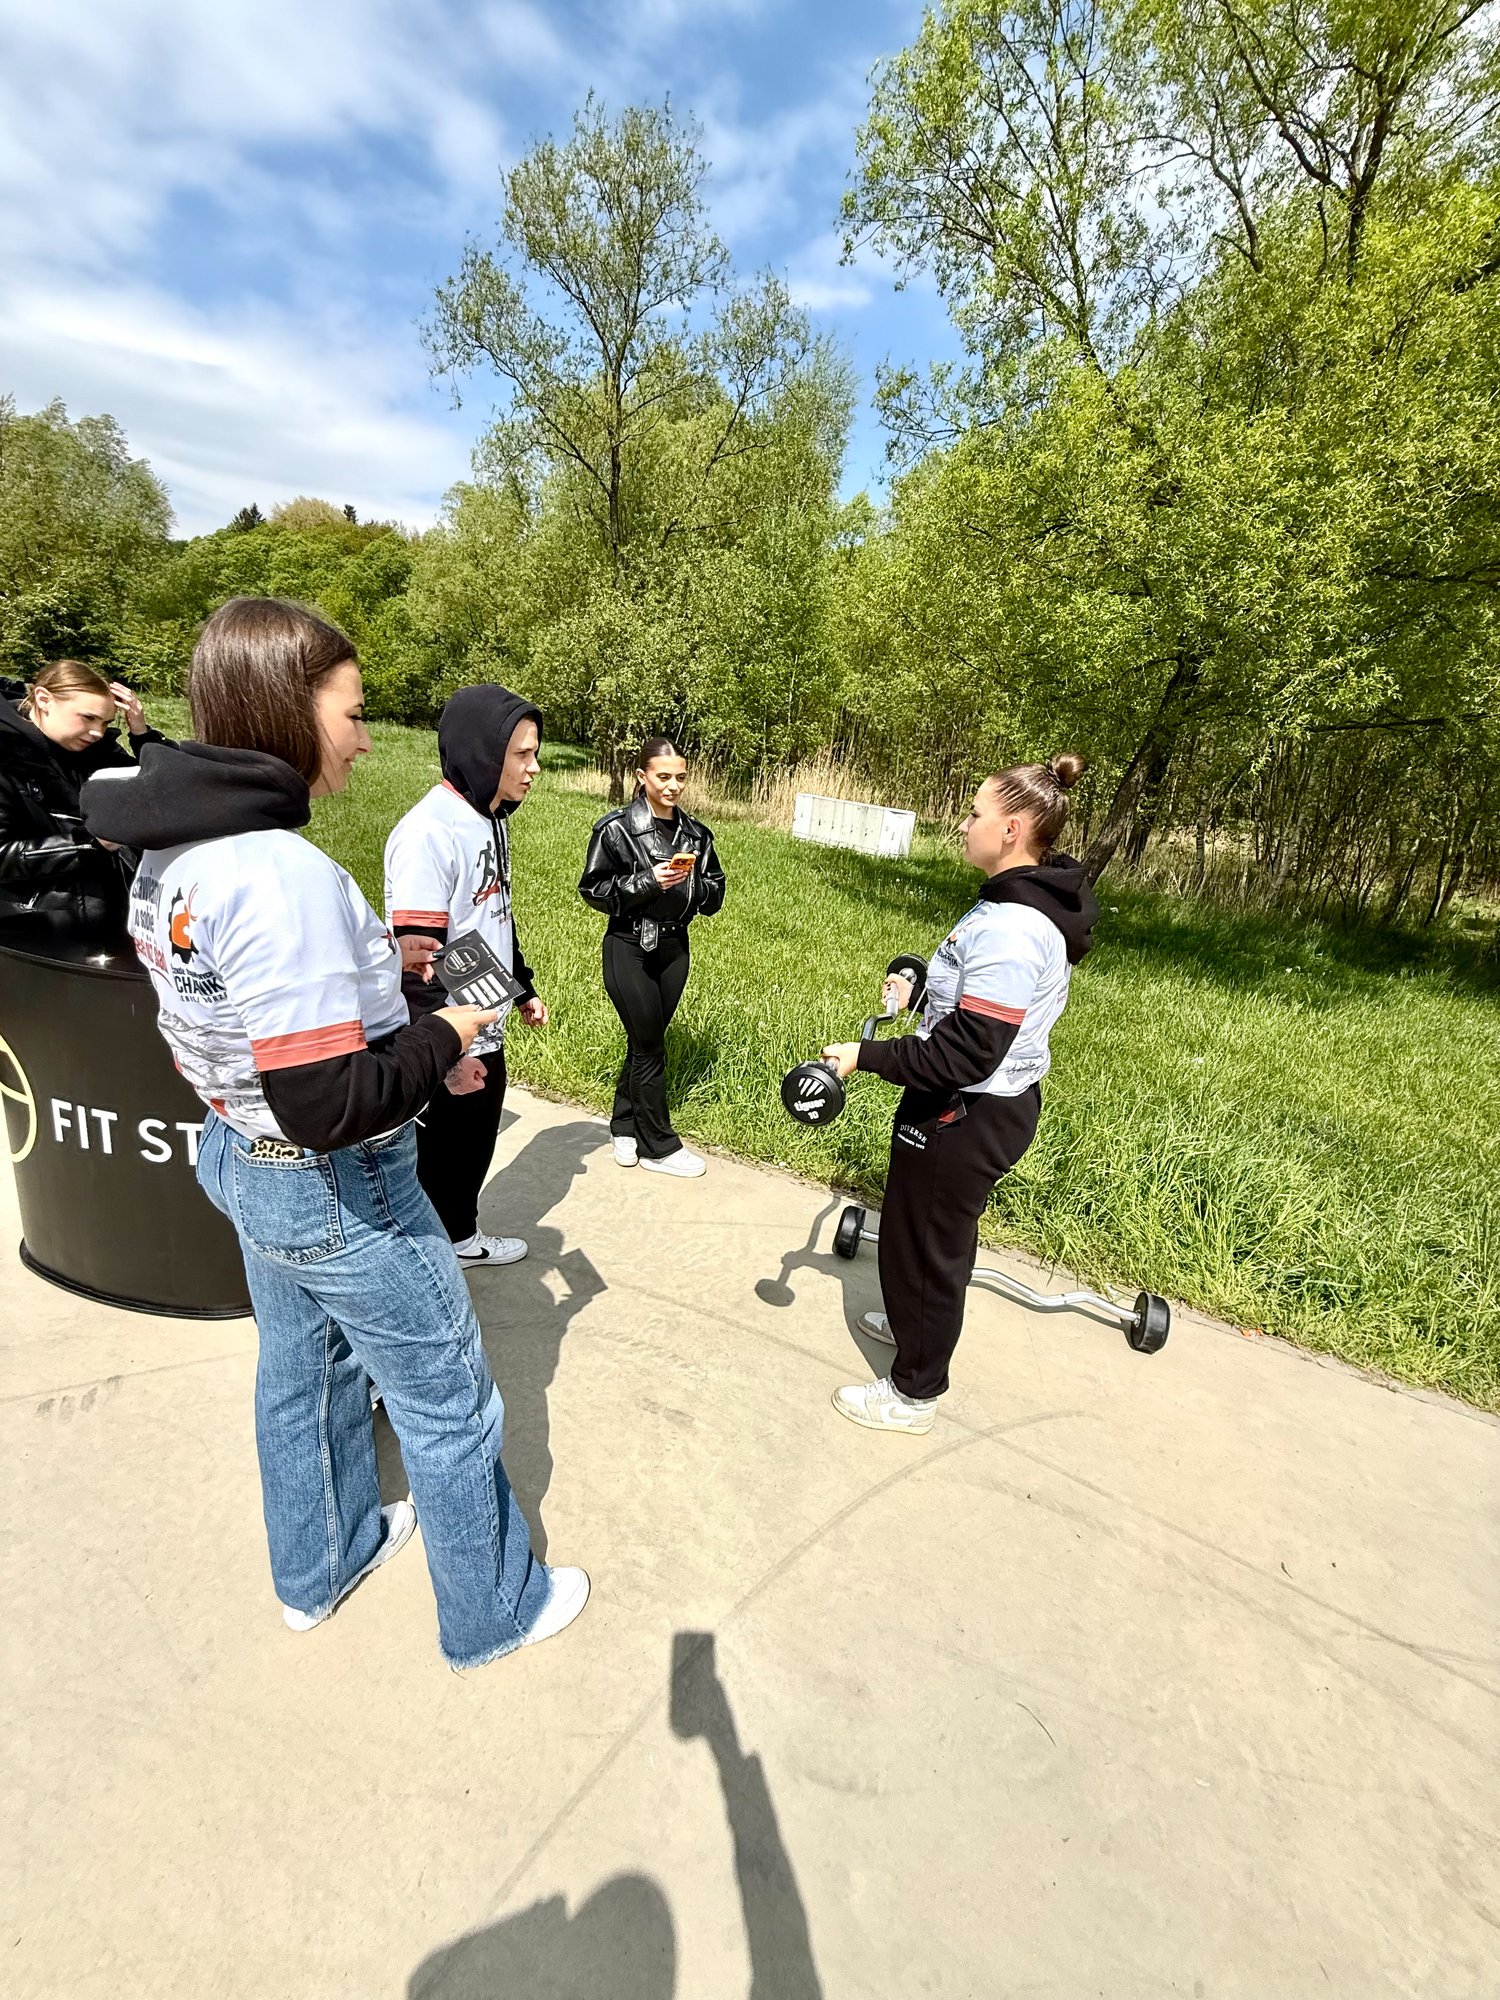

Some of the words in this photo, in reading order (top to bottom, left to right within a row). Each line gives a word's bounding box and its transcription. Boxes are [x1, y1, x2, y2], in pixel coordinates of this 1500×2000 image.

[794, 1098, 826, 1112] tiguar
[808, 1111, 819, 1120] 10
[52, 1098, 118, 1155] FIT
[138, 1119, 205, 1166] ST
[900, 1124, 928, 1144] DIVERSE
